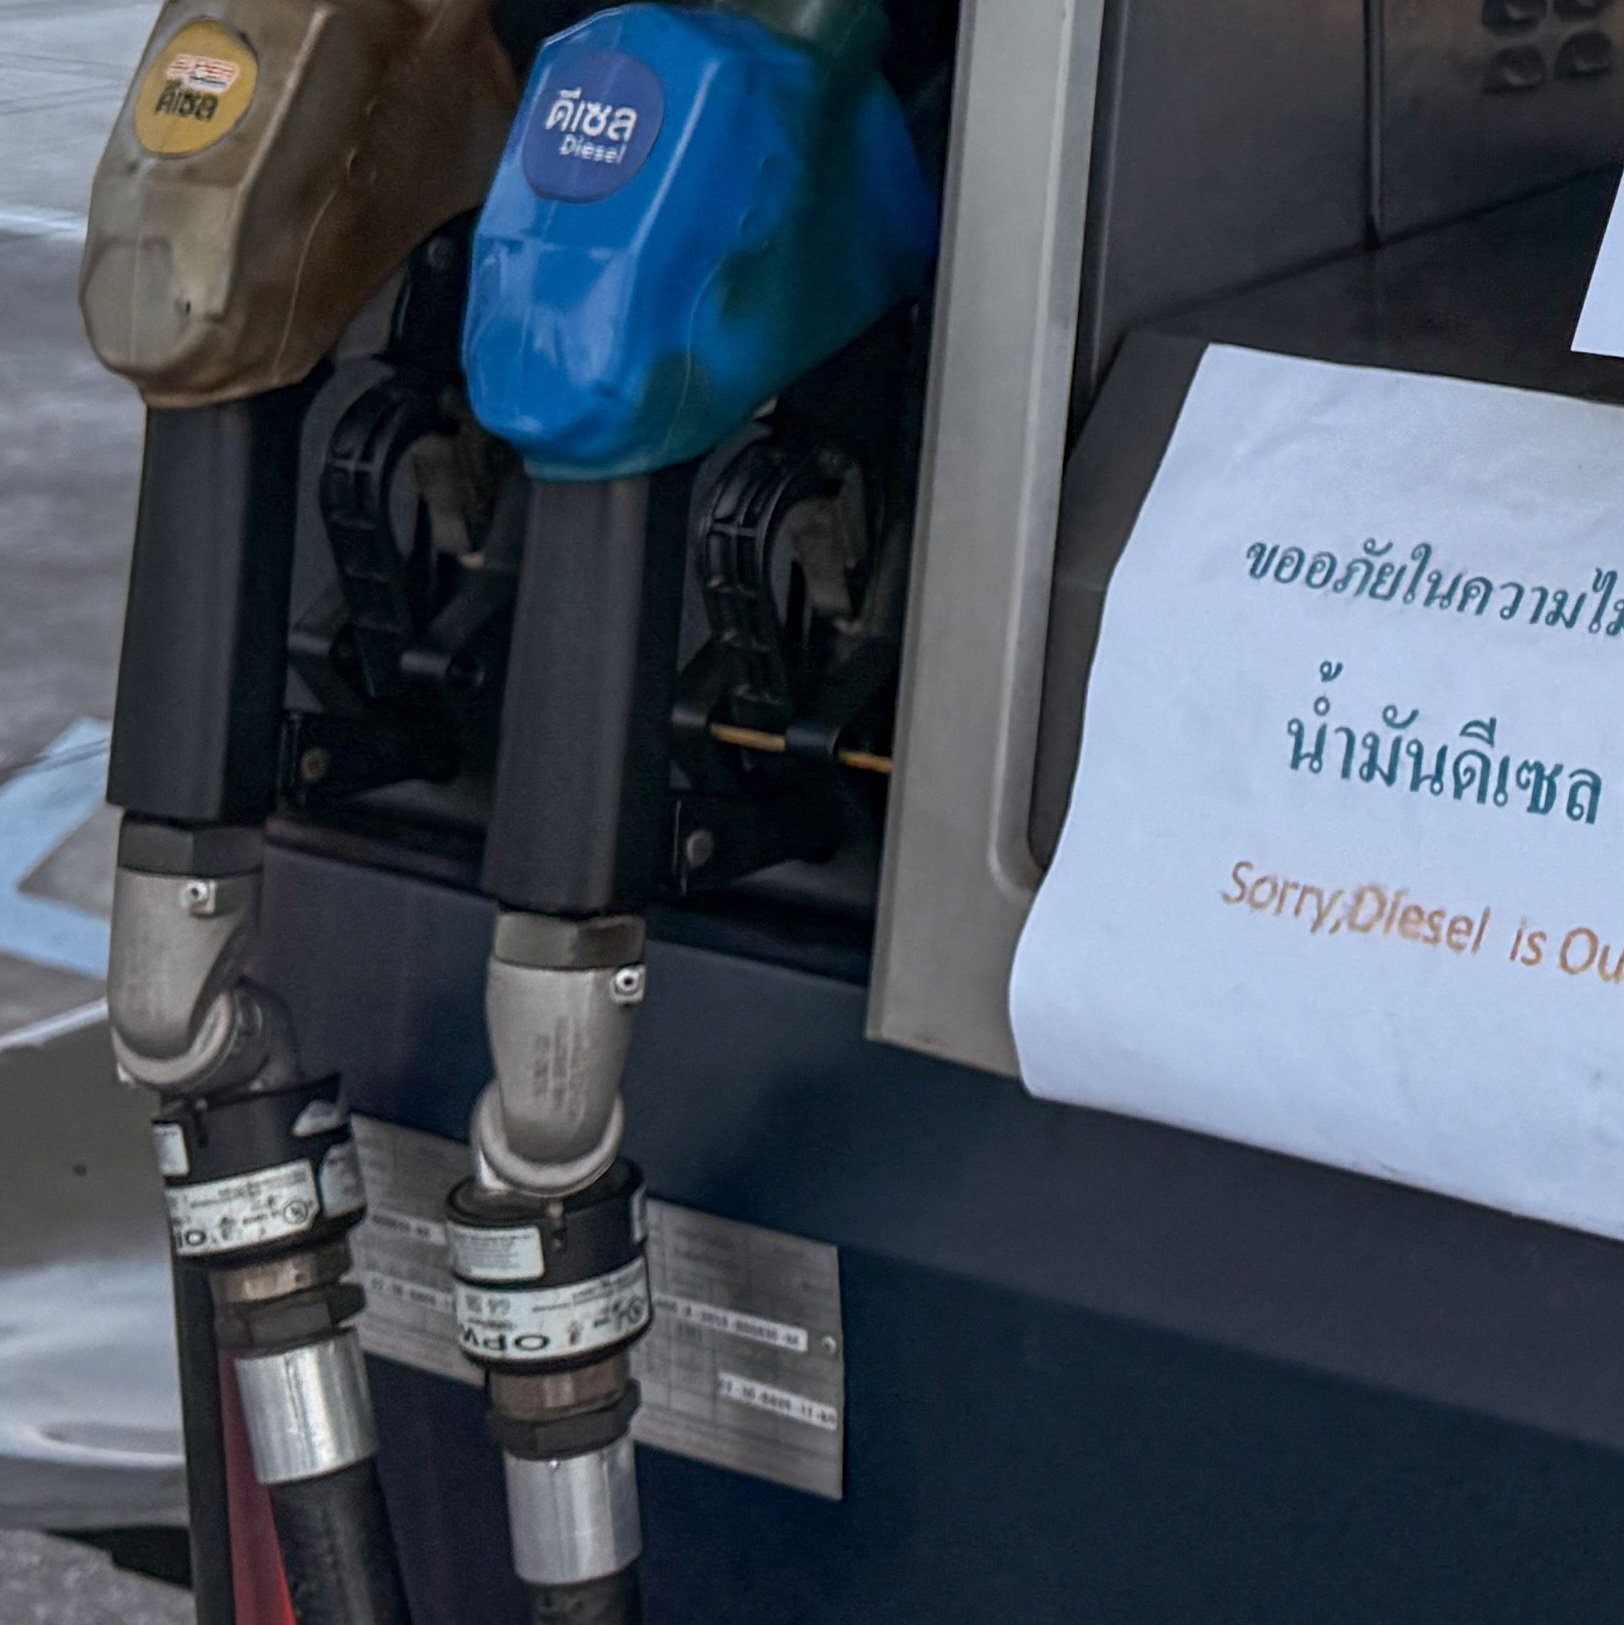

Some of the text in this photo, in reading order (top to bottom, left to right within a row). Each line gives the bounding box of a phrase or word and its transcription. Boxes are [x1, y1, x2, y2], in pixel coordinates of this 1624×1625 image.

[545, 86, 638, 143] ดีเซล
[560, 133, 627, 164] Diesel
[1285, 659, 1602, 827] น้ำมันดีเซล
[1220, 860, 1492, 956] Sorry,Diesel
[1508, 922, 1547, 967] is
